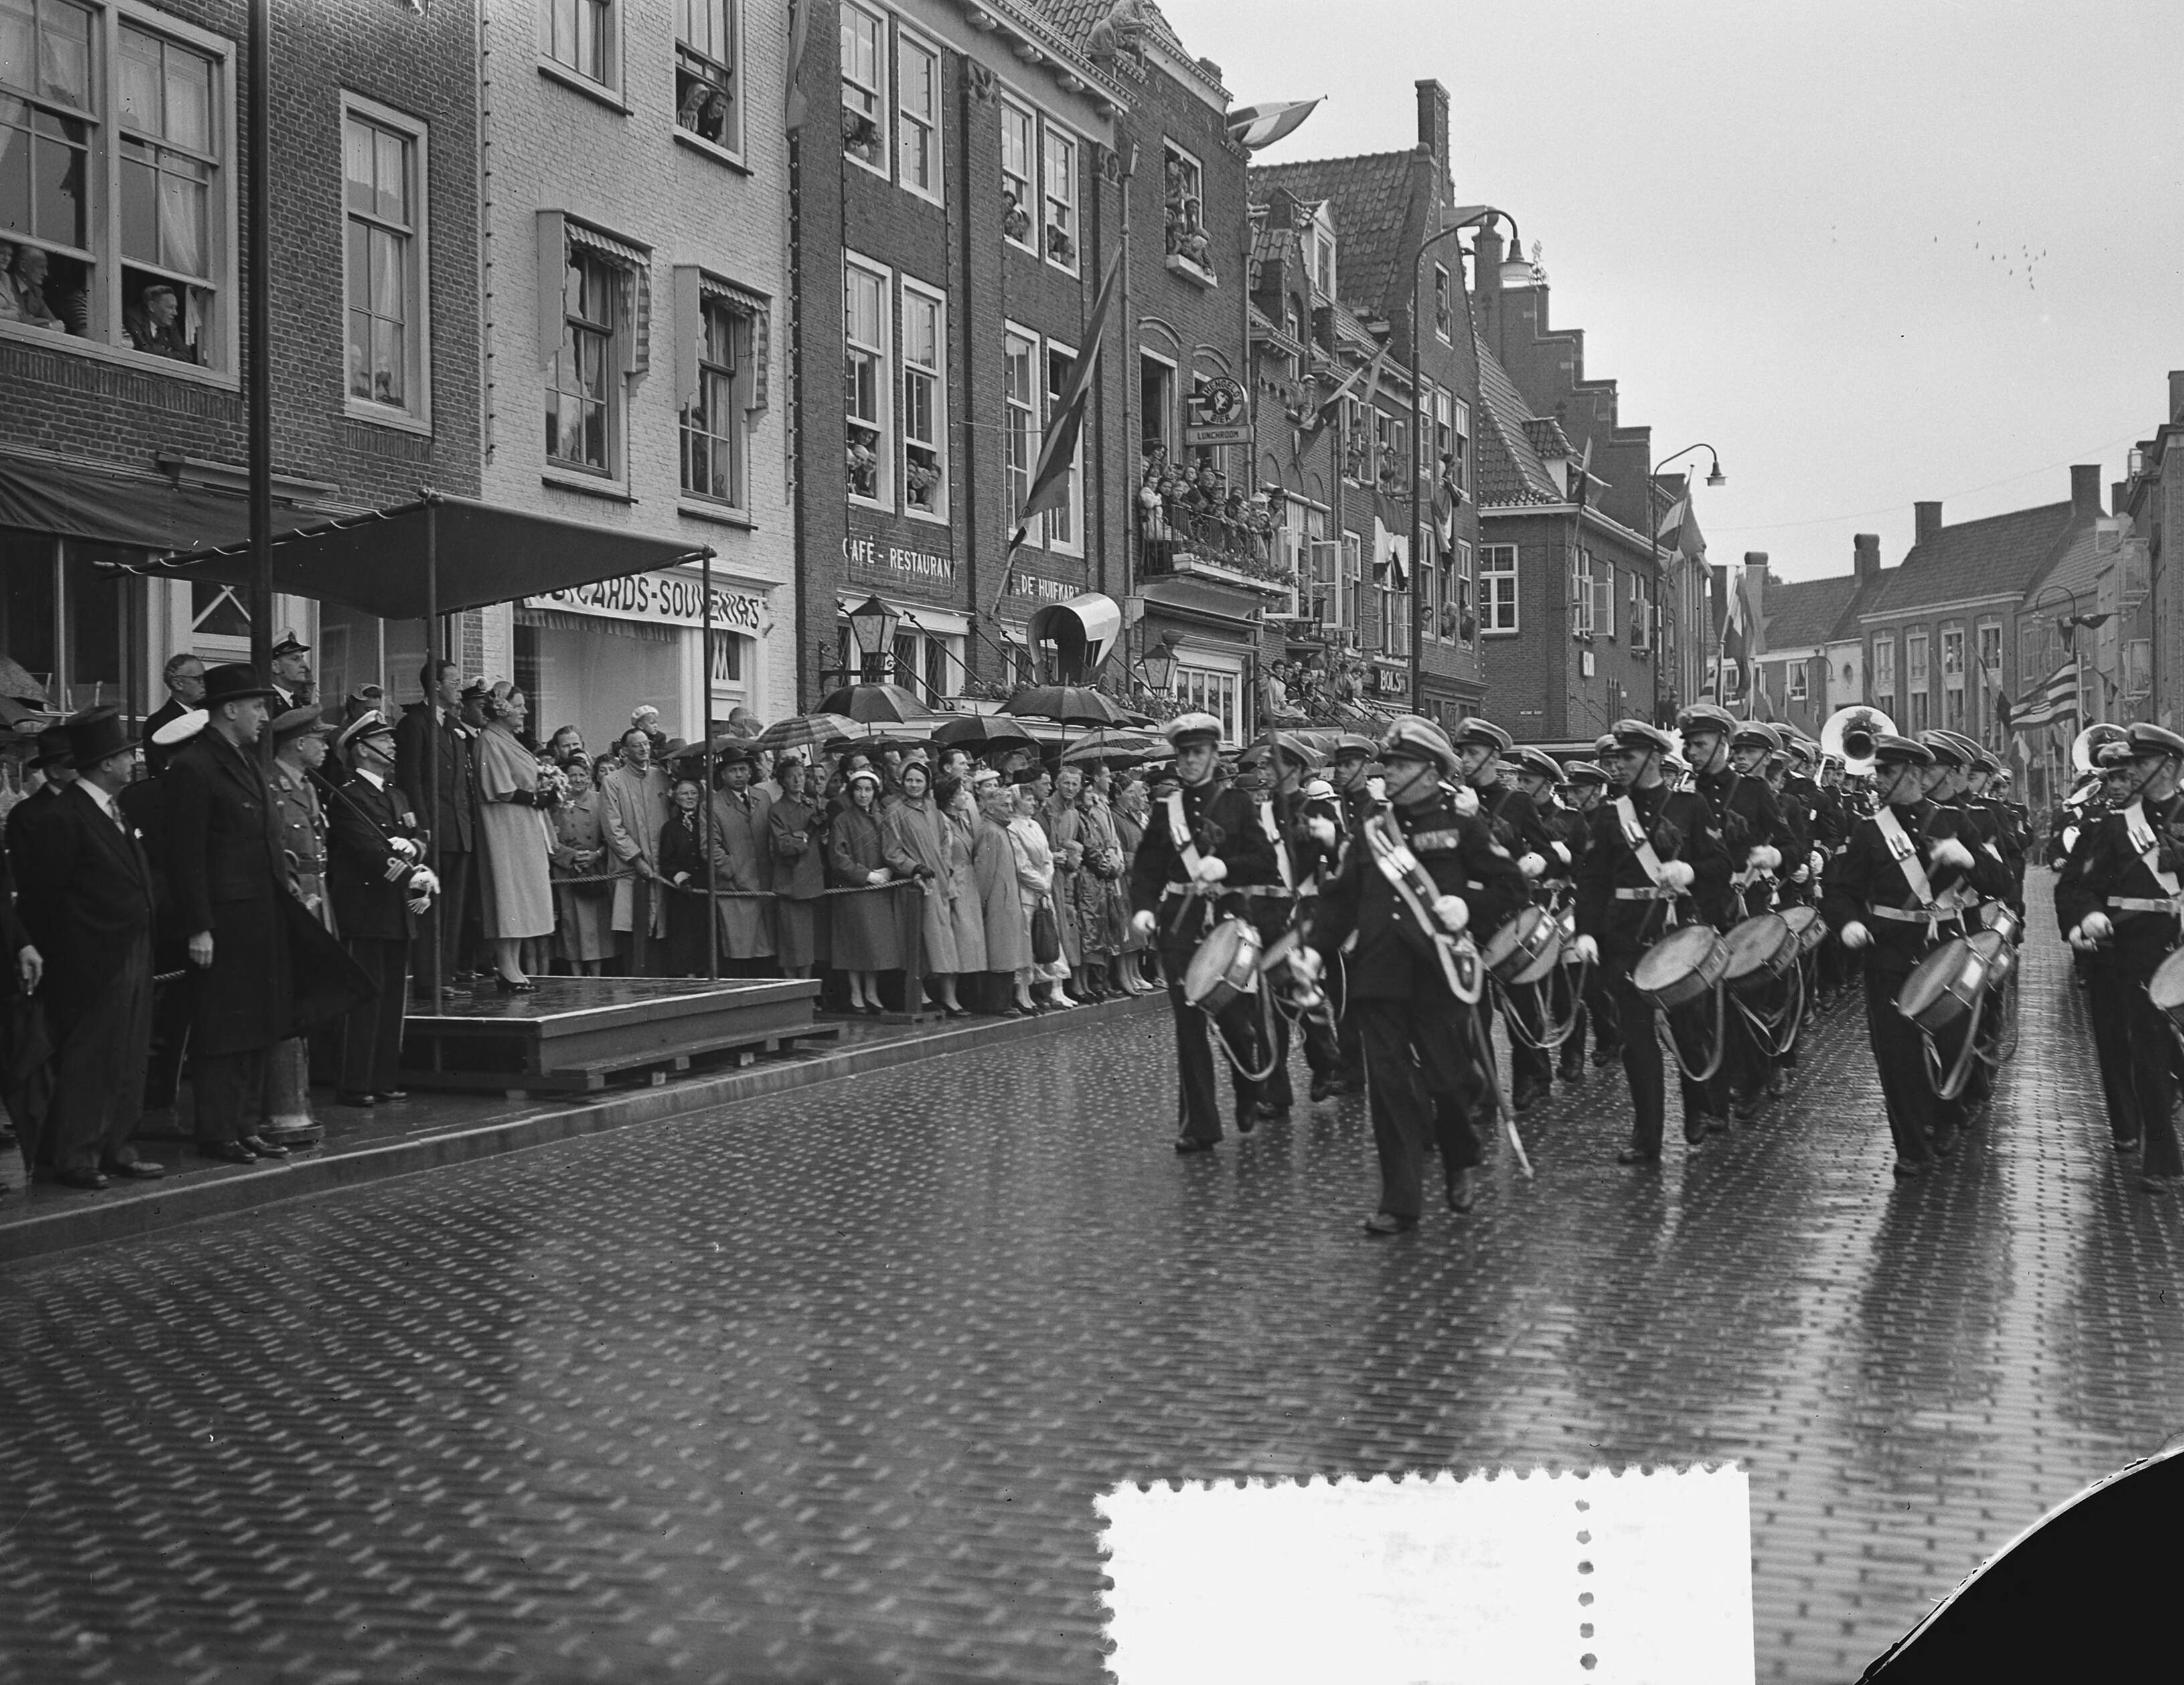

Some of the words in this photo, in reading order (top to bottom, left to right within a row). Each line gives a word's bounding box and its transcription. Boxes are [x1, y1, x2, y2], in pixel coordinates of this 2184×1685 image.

[1209, 414, 1232, 424] BIER
[1196, 430, 1239, 441] LUNCHROOM
[1380, 670, 1401, 692] BOLS
